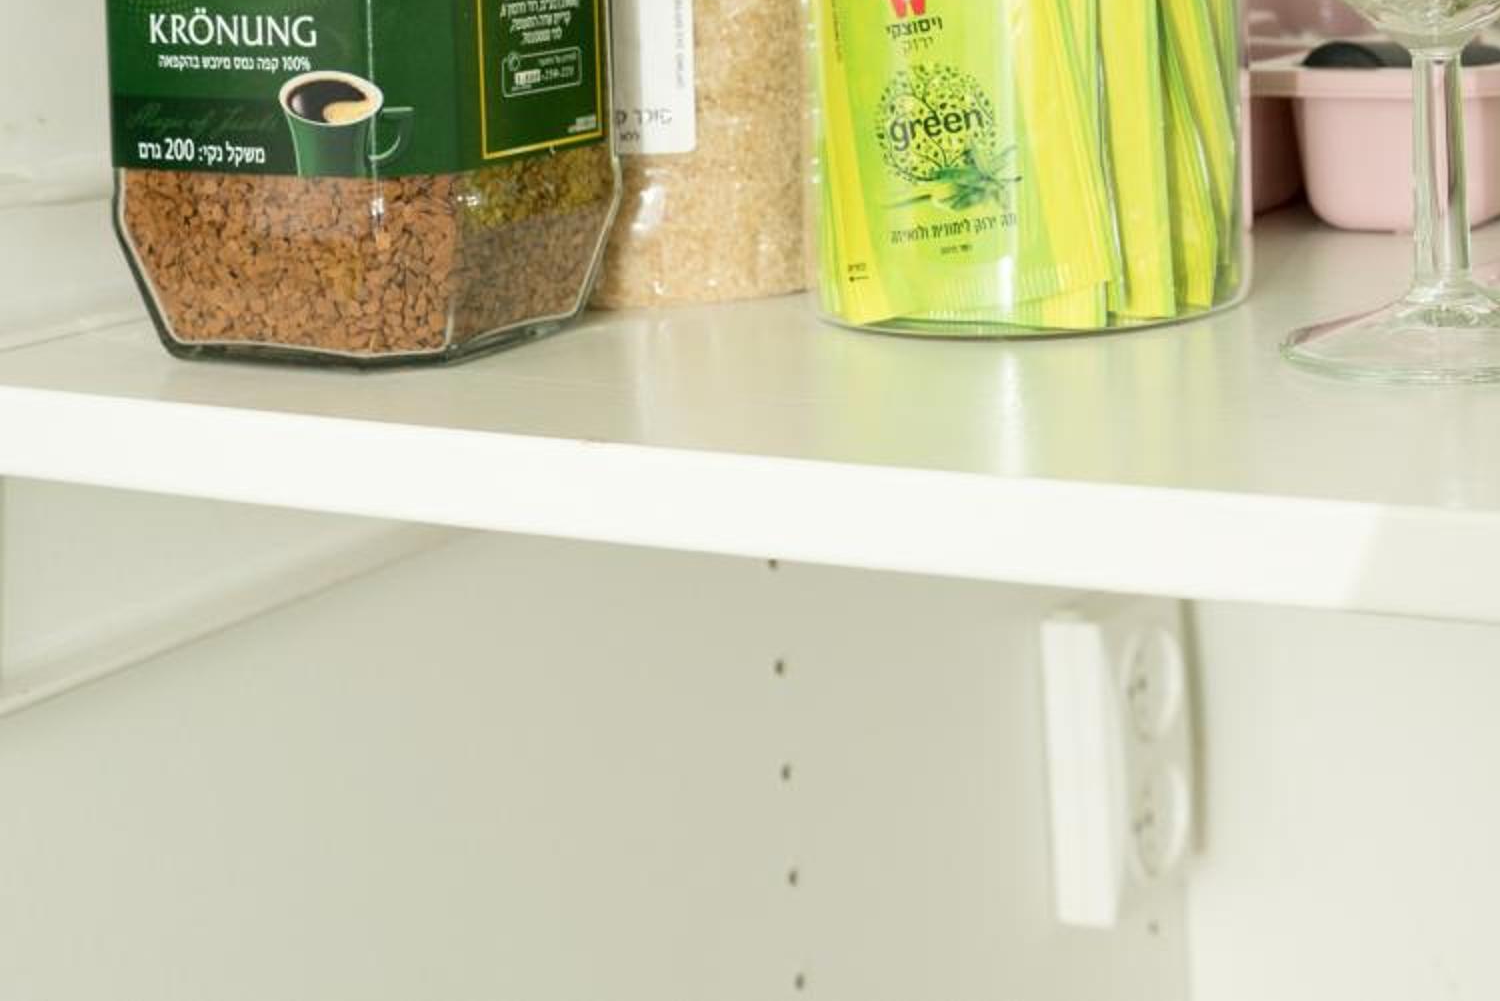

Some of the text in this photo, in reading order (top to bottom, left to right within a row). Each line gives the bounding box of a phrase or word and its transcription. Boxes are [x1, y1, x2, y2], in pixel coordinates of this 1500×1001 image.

[149, 6, 317, 47] KRÖNUNG
[885, 16, 943, 40] ויסוצקי
[158, 54, 311, 73] 100% קפה נמס מיובש בהקפאה
[890, 109, 984, 152] green
[138, 137, 266, 167] משקל נקי: 200 גרם
